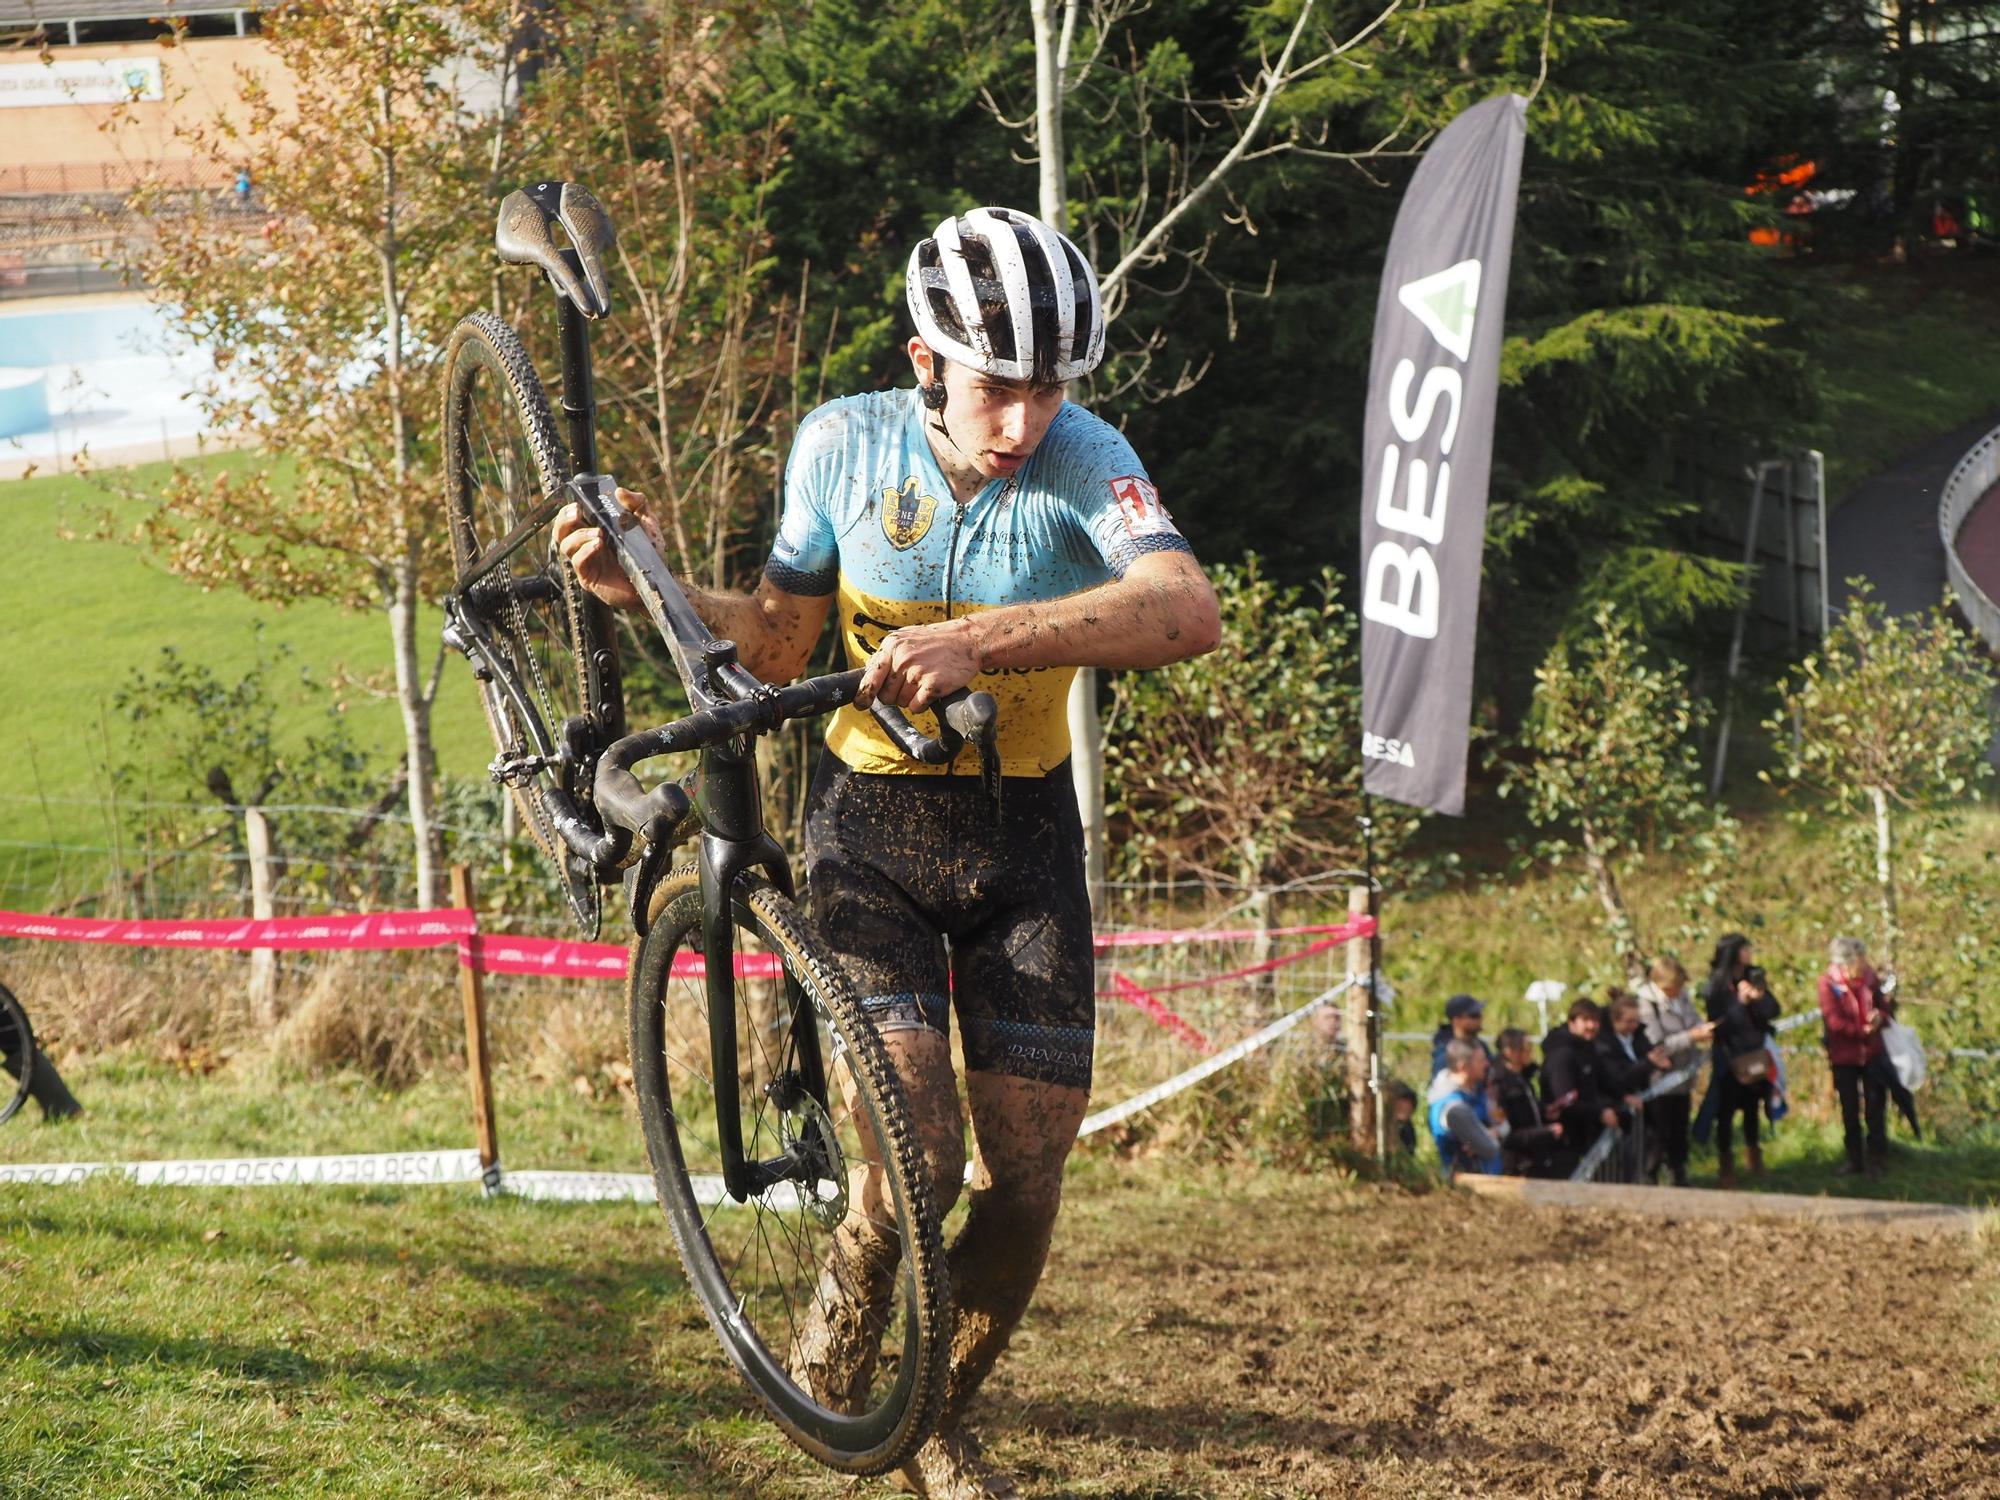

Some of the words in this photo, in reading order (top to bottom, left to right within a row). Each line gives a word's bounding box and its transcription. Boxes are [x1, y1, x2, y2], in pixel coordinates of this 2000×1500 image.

[1363, 258, 1482, 640] BESA
[597, 494, 621, 518] BOONE
[1119, 483, 1147, 521] 1
[823, 1018, 849, 1055] DT
